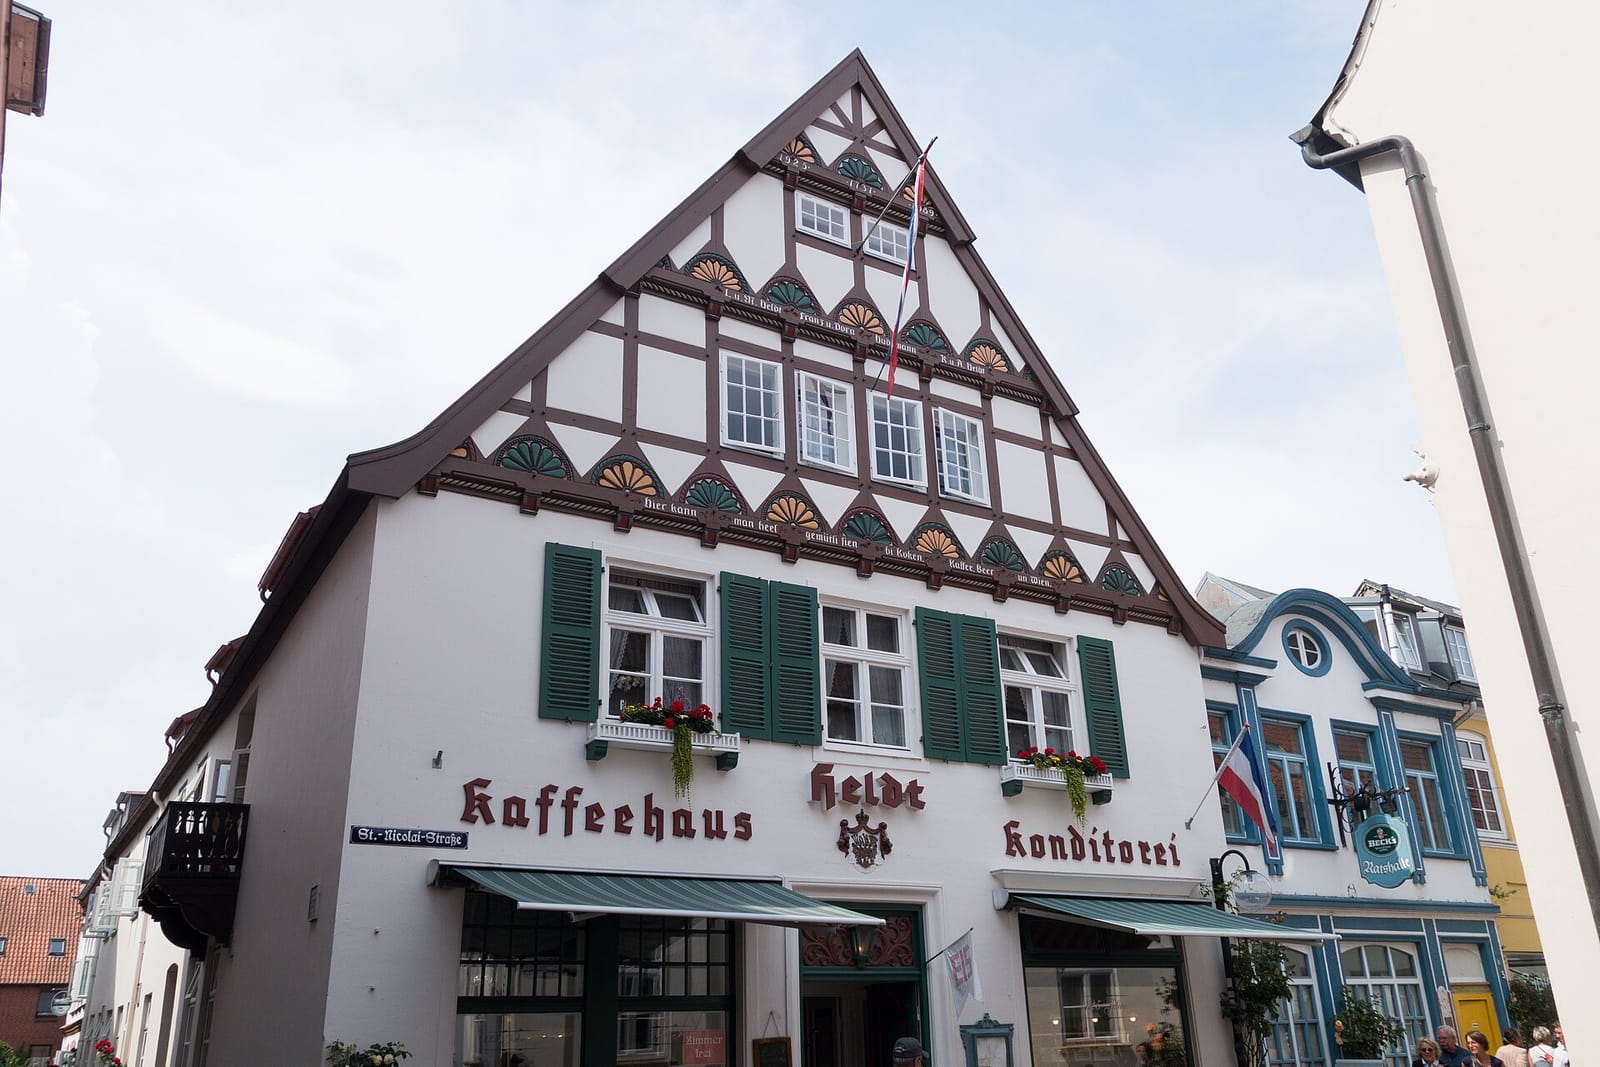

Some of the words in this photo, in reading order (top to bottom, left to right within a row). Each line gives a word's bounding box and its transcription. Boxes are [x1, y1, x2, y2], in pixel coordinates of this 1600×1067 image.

[644, 496, 667, 511] Hier
[670, 503, 698, 517] kann
[460, 777, 752, 842] Kaffeehaus
[1003, 819, 1181, 866] Konditorei
[1363, 857, 1411, 875] Ratshalle
[949, 944, 973, 989] EIS
[686, 1036, 723, 1045] Zimmer
